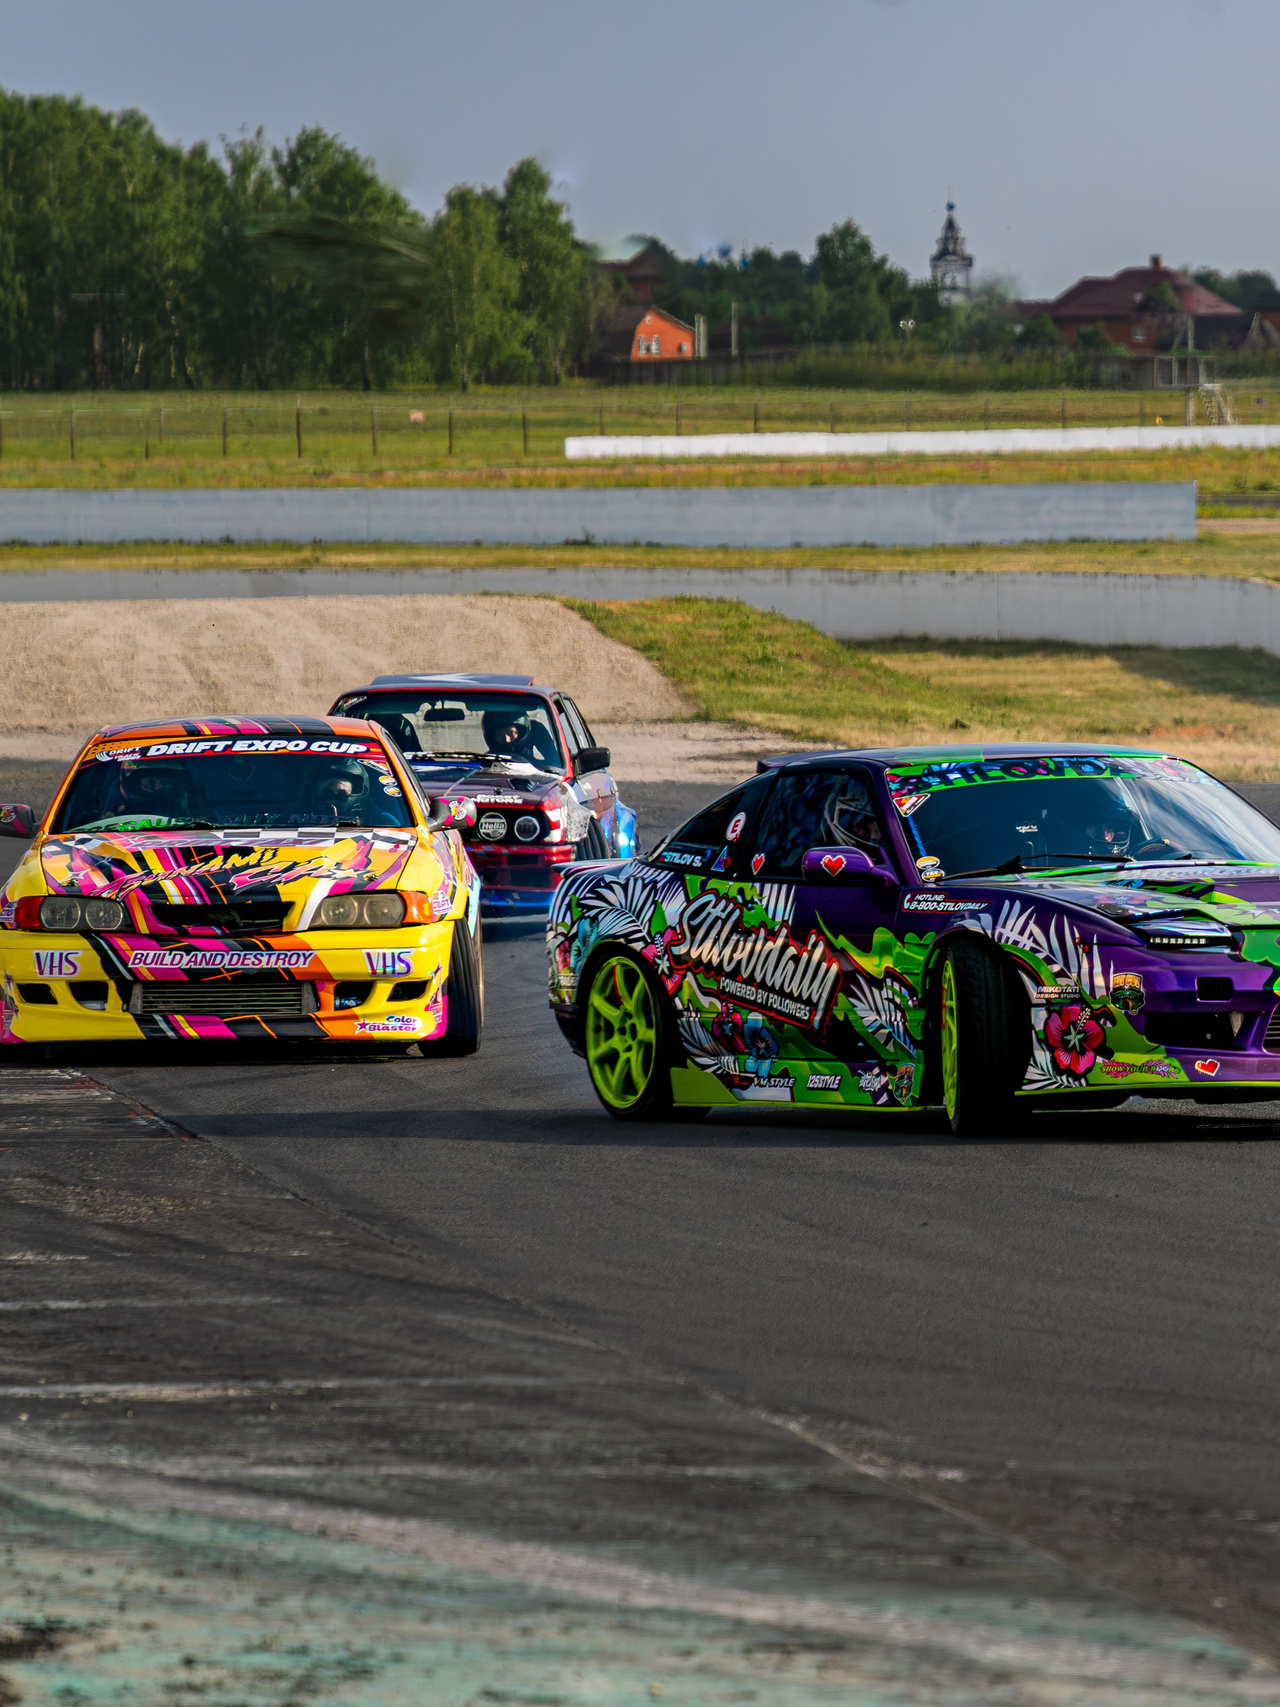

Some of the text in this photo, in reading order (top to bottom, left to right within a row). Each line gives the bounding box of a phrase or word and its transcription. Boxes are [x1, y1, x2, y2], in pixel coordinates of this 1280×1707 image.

[108, 746, 142, 756] DRIFT
[146, 740, 368, 756] DRIFT EXPO CUP
[481, 822, 505, 830] Hella
[731, 819, 741, 834] E
[664, 851, 695, 865] STILOV
[909, 901, 988, 911] 8-800-STILOVDAILY
[34, 952, 80, 976] VHS
[130, 952, 315, 967] BUILD AND DESTROY
[364, 951, 412, 976] VHS
[720, 977, 809, 1020] POWERED BY FOLLOWERS
[386, 1015, 416, 1023] Color
[753, 1076, 796, 1086] VM STYLE
